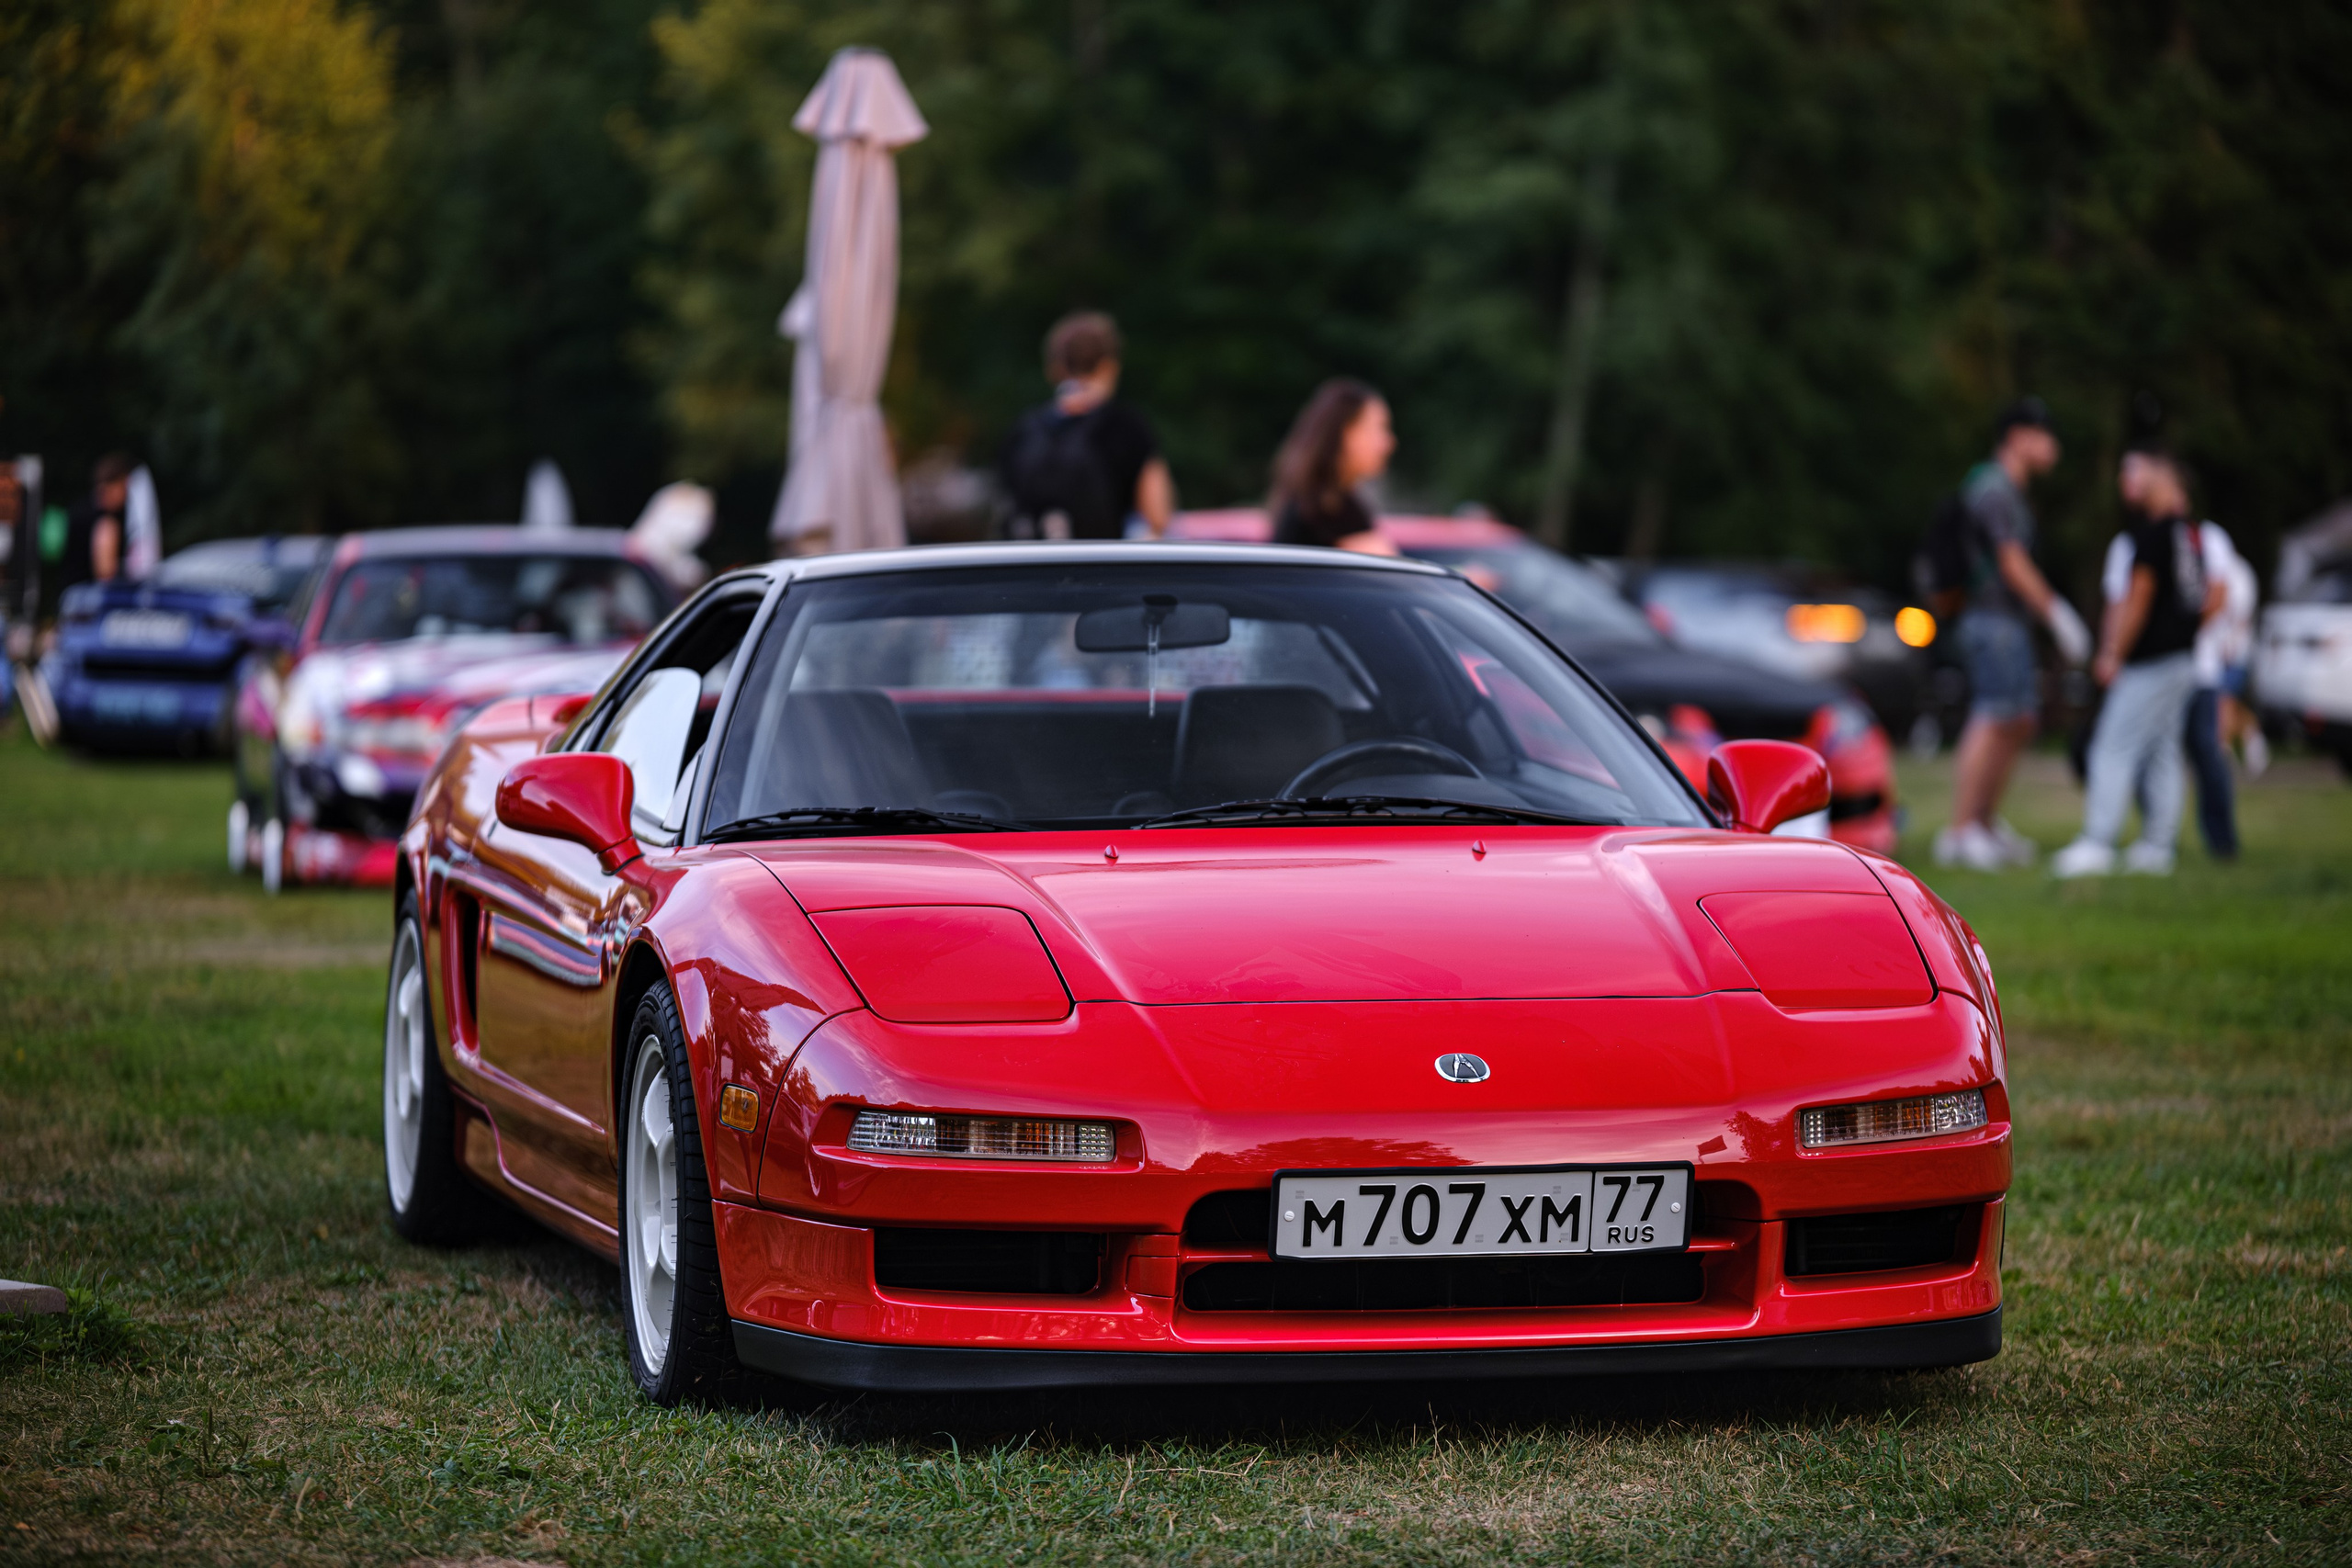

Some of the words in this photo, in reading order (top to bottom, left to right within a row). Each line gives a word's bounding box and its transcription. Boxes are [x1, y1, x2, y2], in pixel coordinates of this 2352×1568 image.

[1359, 1182, 1487, 1247] 707
[1602, 1175, 1665, 1223] 77
[1607, 1224, 1655, 1244] RUS
